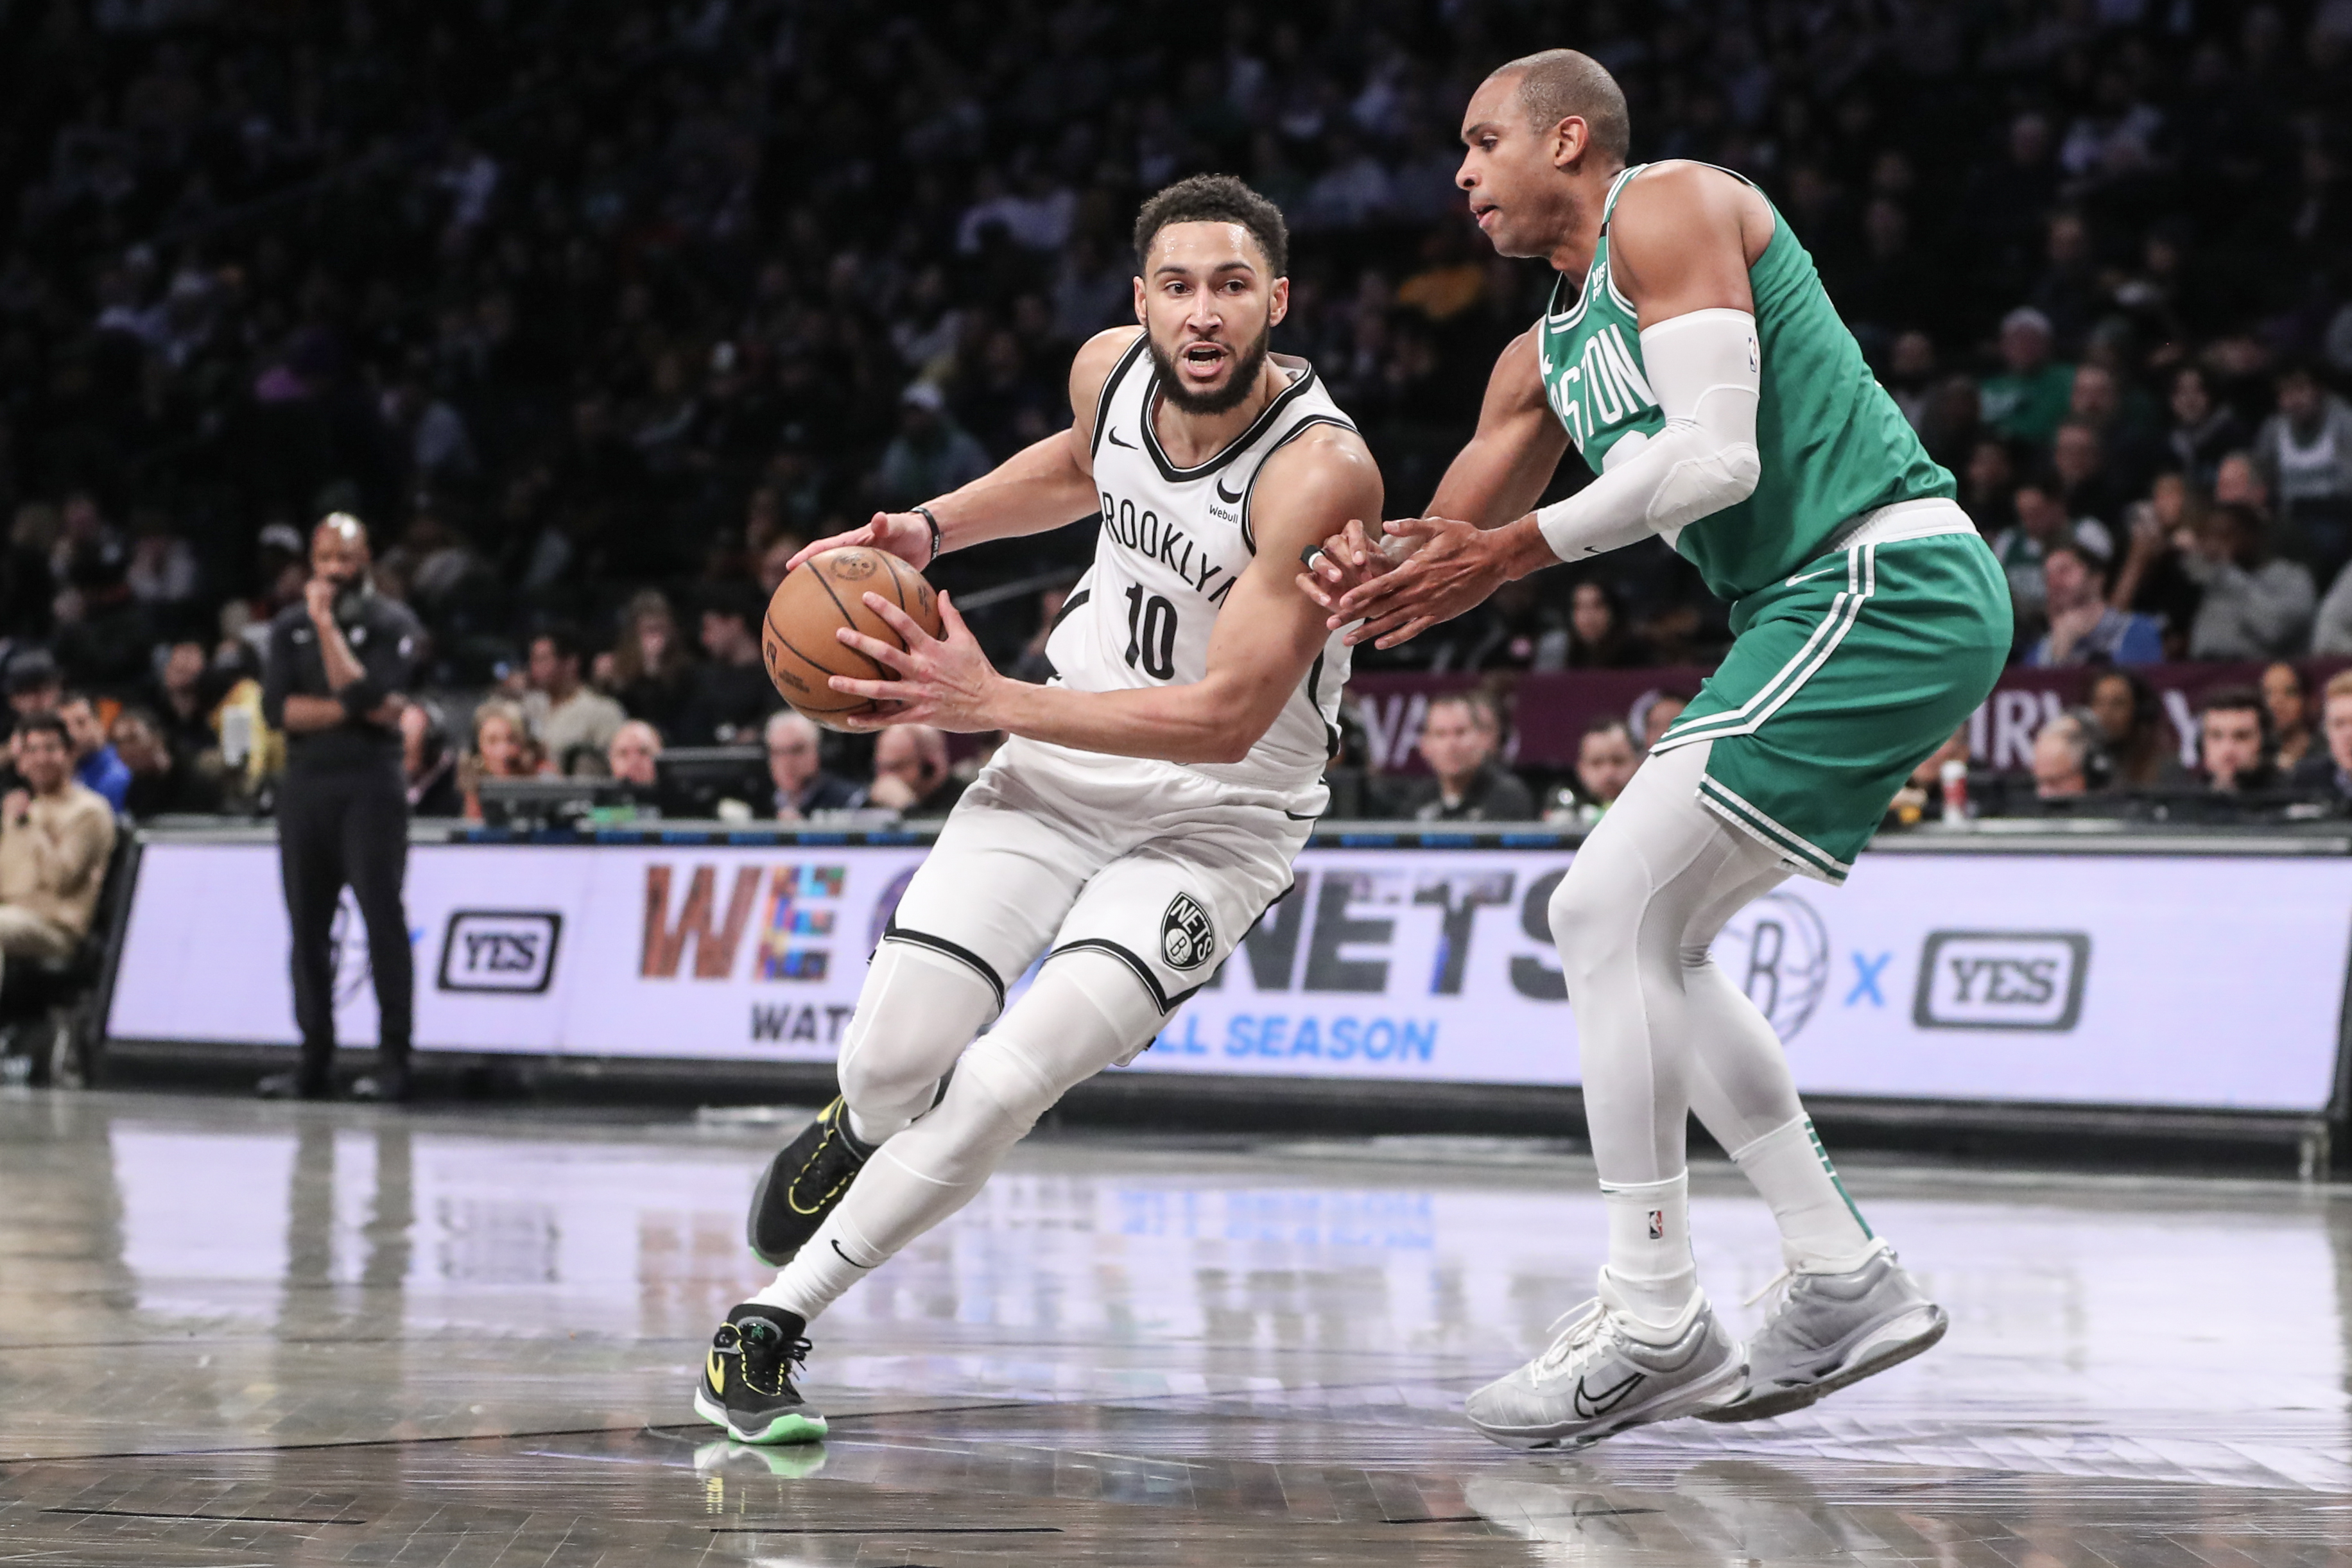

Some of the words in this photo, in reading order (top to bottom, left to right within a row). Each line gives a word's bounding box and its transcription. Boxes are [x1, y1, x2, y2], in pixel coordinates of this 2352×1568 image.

[1592, 261, 1607, 288] VIS
[1550, 323, 1659, 454] OSTON
[1209, 504, 1239, 524] Webull
[1102, 490, 1238, 610] ROOKLY
[1125, 581, 1178, 680] 10
[467, 932, 538, 970] YES
[641, 863, 846, 983] WE
[1170, 899, 1213, 961] NETS
[1950, 958, 2057, 1004] YES
[751, 1003, 854, 1042] WAT
[1225, 1013, 1438, 1061] SEASON
